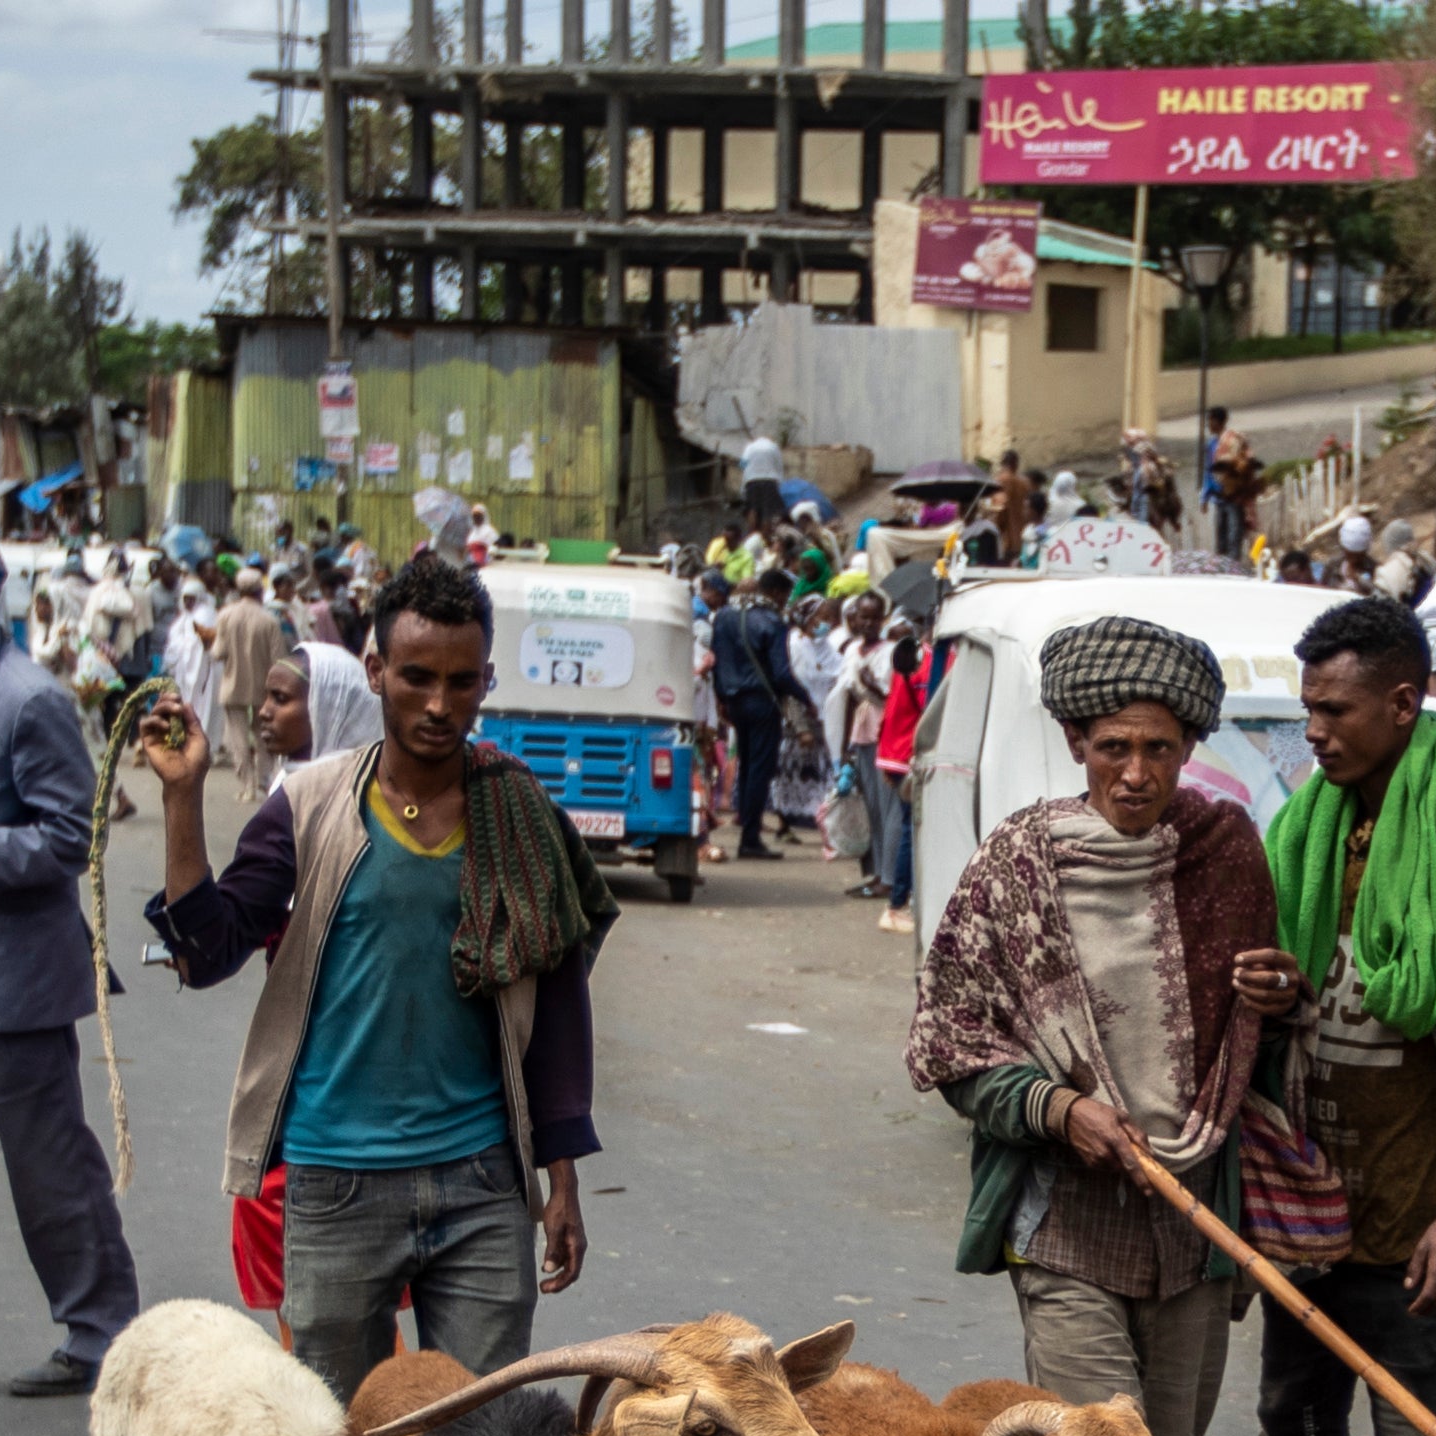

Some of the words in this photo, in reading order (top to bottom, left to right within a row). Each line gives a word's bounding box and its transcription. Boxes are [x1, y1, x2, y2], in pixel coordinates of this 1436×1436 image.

[1157, 86, 1249, 115] HAILE
[1253, 83, 1372, 114] RESORT
[1022, 141, 1061, 154] HAILE
[1062, 140, 1111, 154] RESORT
[1036, 160, 1090, 178] Gondar
